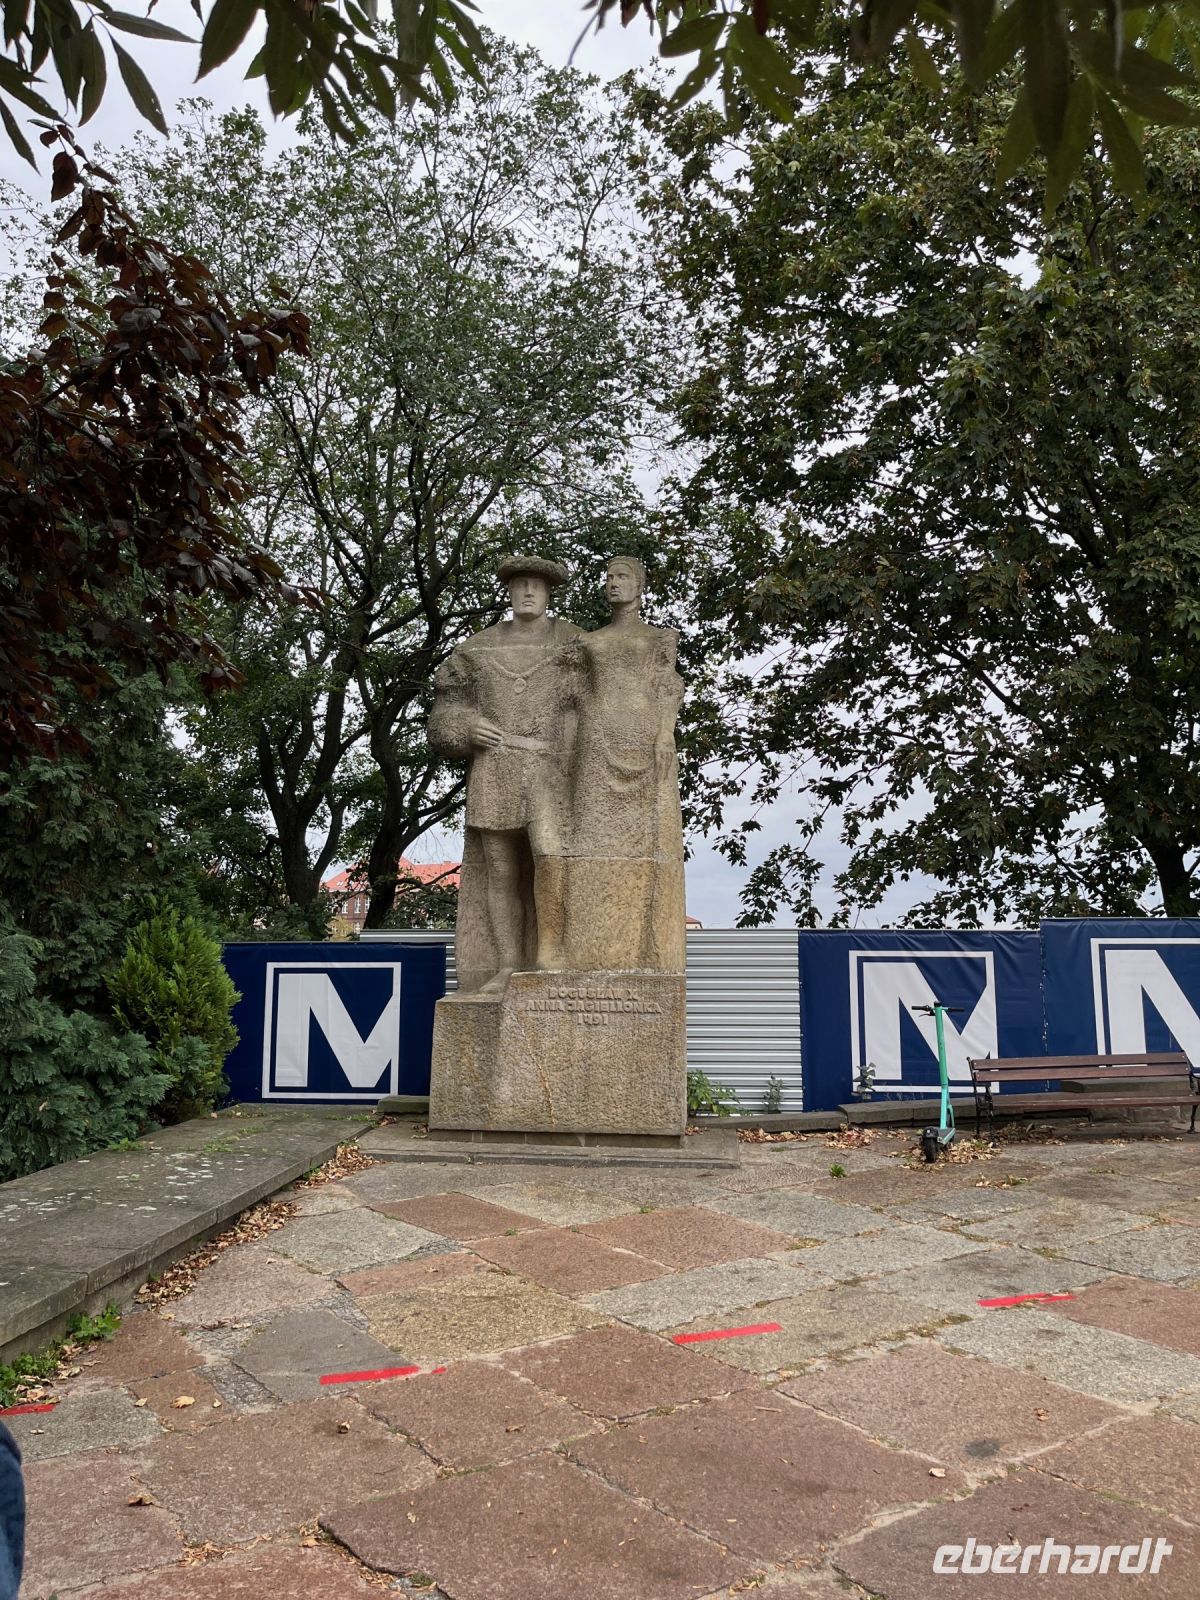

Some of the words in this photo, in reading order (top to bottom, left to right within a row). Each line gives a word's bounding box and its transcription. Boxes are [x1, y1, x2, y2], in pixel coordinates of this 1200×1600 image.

[526, 1000, 565, 1012] ANNA
[567, 1000, 663, 1014] JAGIELLONKA
[577, 1013, 609, 1026] 1491
